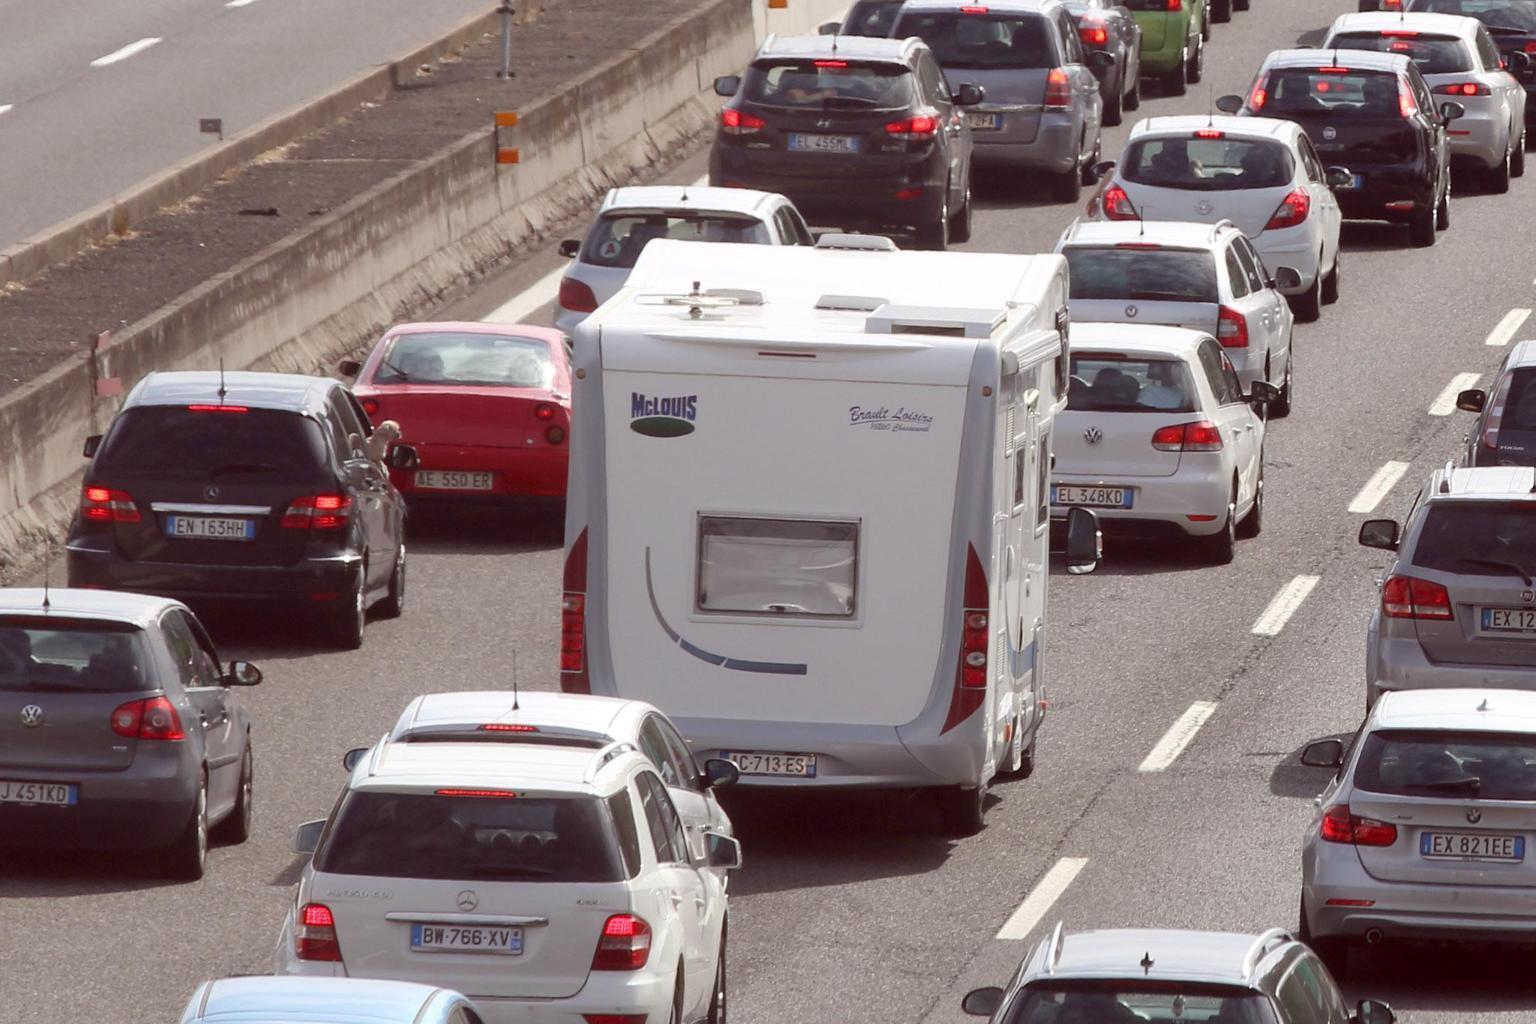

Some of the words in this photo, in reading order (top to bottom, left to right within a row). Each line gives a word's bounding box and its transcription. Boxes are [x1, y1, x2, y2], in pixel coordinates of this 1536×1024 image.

[416, 472, 433, 486] AE
[442, 473, 468, 487] 550
[472, 473, 491, 488] ER
[1058, 488, 1075, 502] EL
[1080, 489, 1122, 504] 348KD
[176, 519, 194, 535] EN
[199, 520, 244, 537] 163HH
[1493, 611, 1511, 627] EX
[16, 785, 67, 802] 451KD
[1433, 836, 1453, 854] EX
[1460, 837, 1512, 855] 821EE
